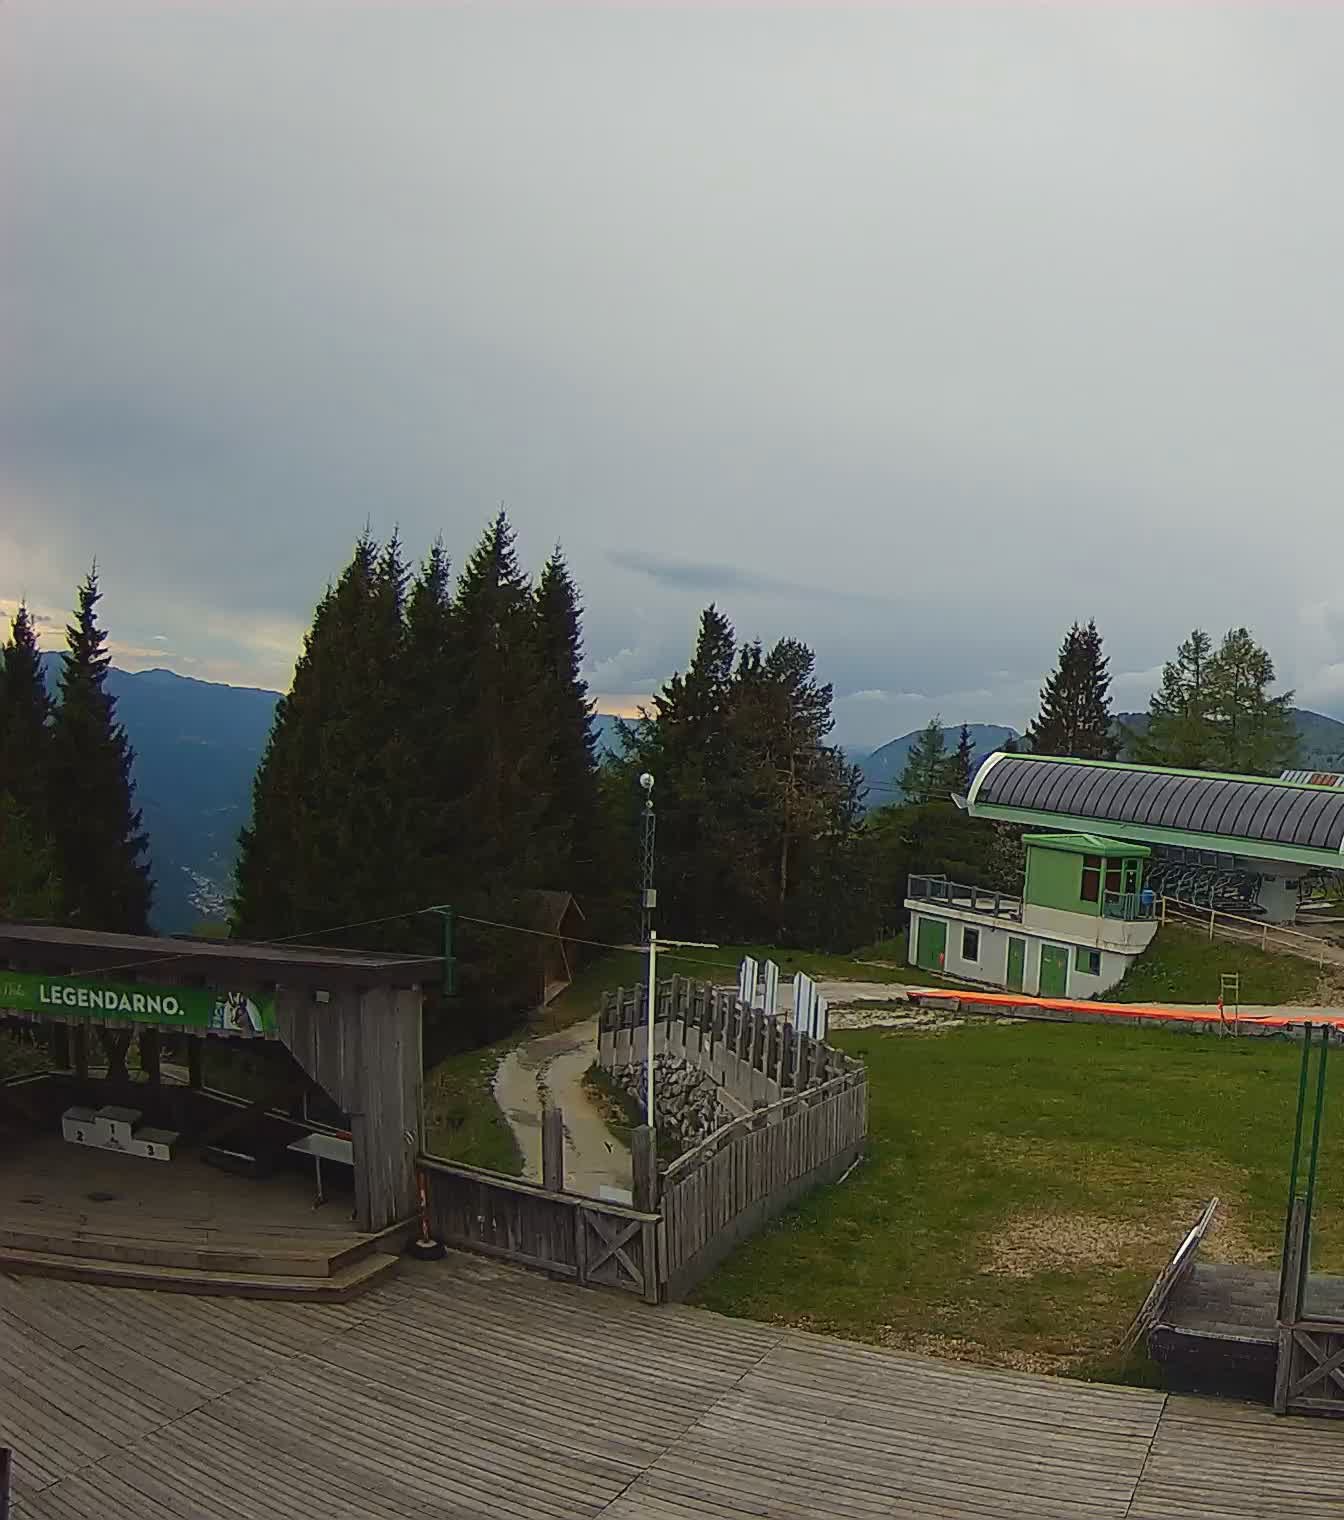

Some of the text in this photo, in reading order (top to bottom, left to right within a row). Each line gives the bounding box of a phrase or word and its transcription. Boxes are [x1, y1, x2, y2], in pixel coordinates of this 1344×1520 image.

[39, 983, 185, 1016] LEGENDARNO.
[76, 1130, 84, 1142] 2
[146, 1144, 155, 1157] 3
